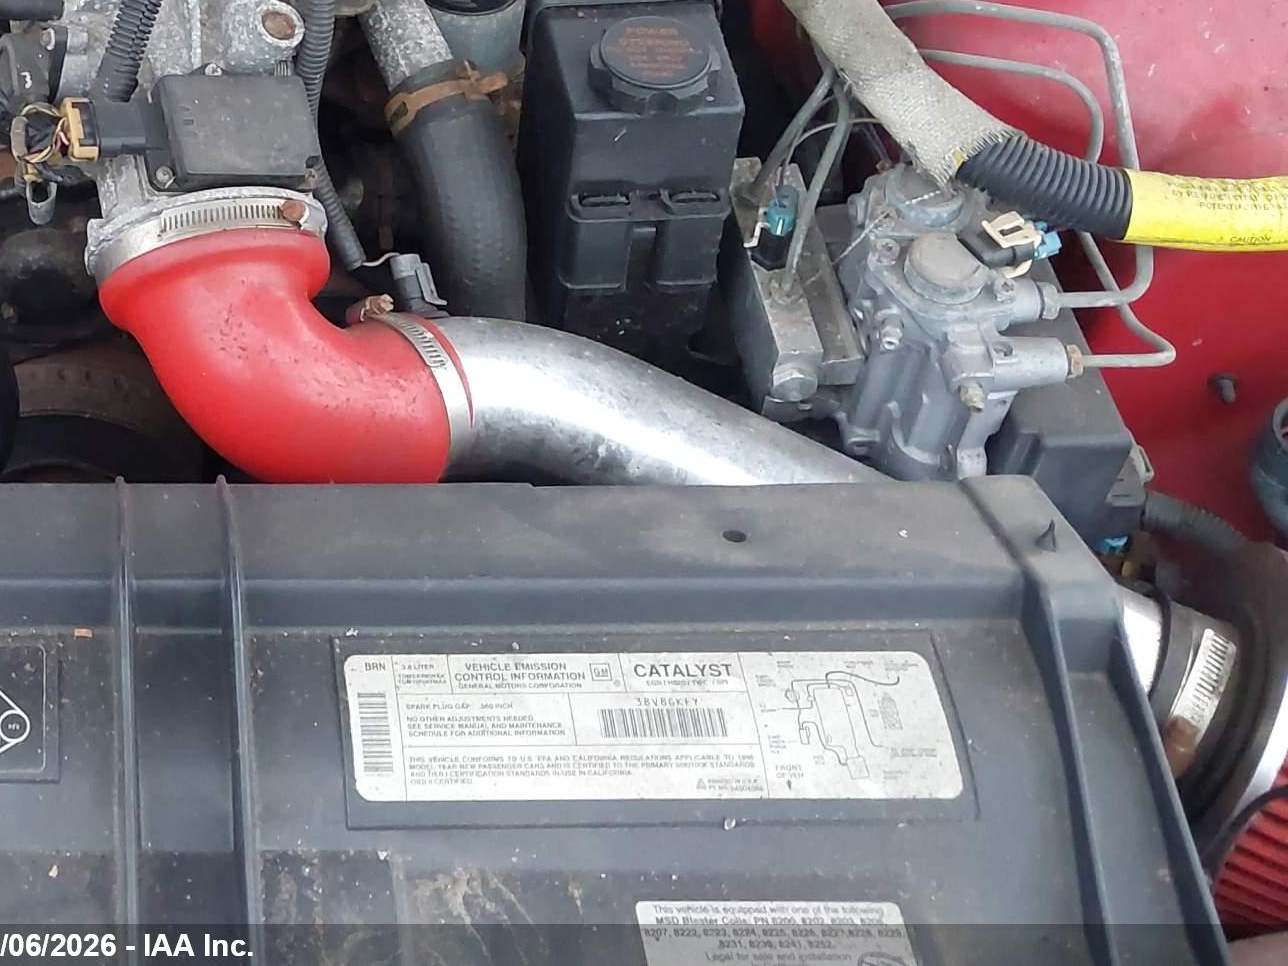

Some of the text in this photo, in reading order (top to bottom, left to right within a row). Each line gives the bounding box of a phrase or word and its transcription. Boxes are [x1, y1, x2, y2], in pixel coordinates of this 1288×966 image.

[1230, 233, 1272, 244] CAUTION
[364, 662, 386, 672] BRN
[464, 662, 567, 672] VEHICLE EMISSION
[593, 667, 609, 677] GM
[633, 663, 733, 677] CATALYST
[454, 672, 508, 682] CONTROL
[510, 672, 586, 682] INFORMATION
[458, 682, 583, 690] GENERAL MOTORS CORPORATION
[656, 917, 680, 925] MSD
